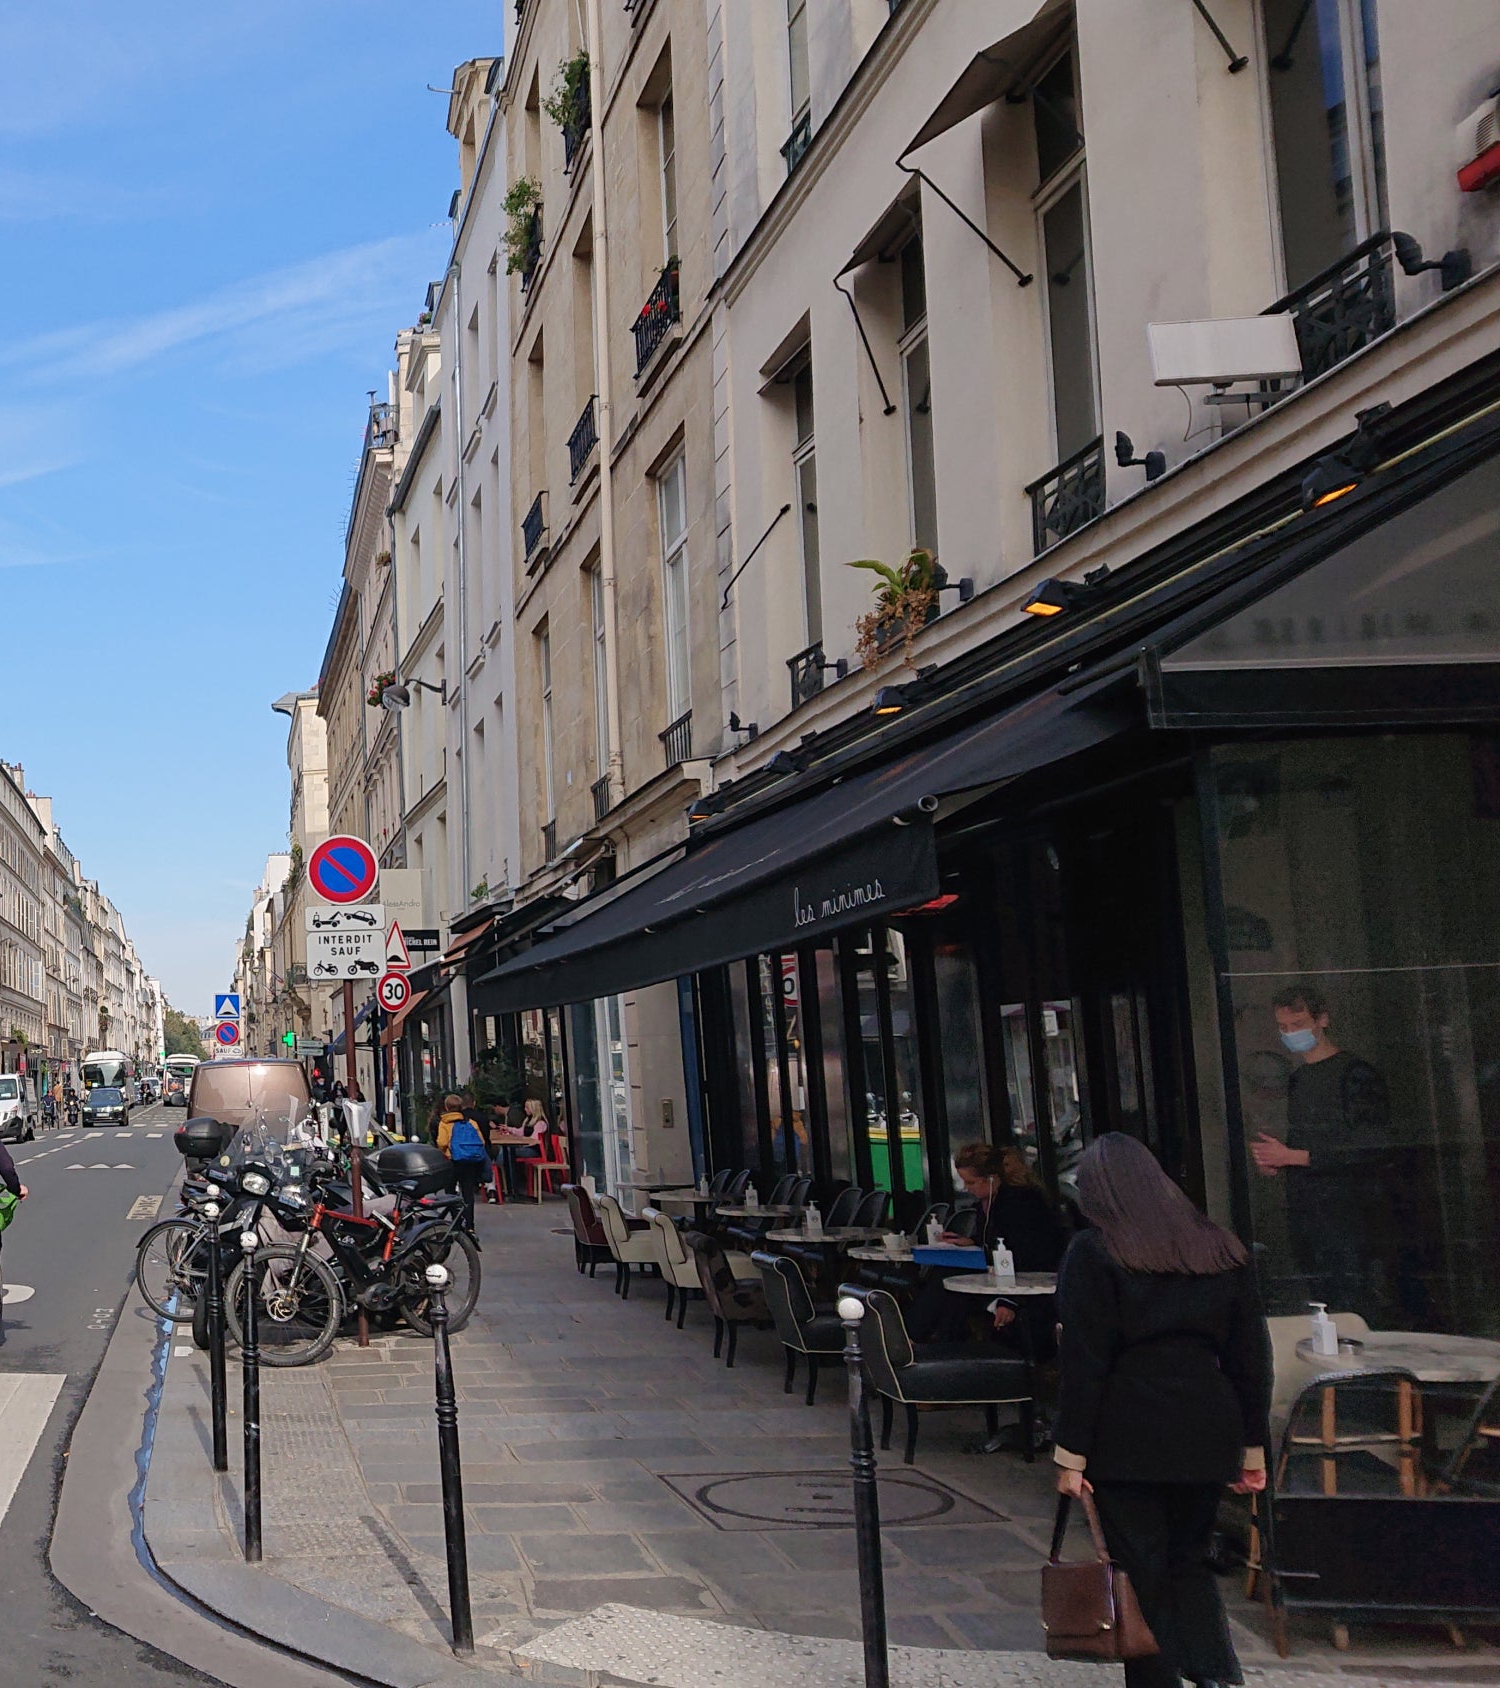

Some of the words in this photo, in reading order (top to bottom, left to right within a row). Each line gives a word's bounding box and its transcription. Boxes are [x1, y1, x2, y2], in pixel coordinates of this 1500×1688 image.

[794, 887, 816, 927] les
[821, 879, 886, 918] minimes
[318, 934, 372, 944] INTERDIT
[330, 947, 361, 956] SAUF
[384, 983, 405, 1000] 30
